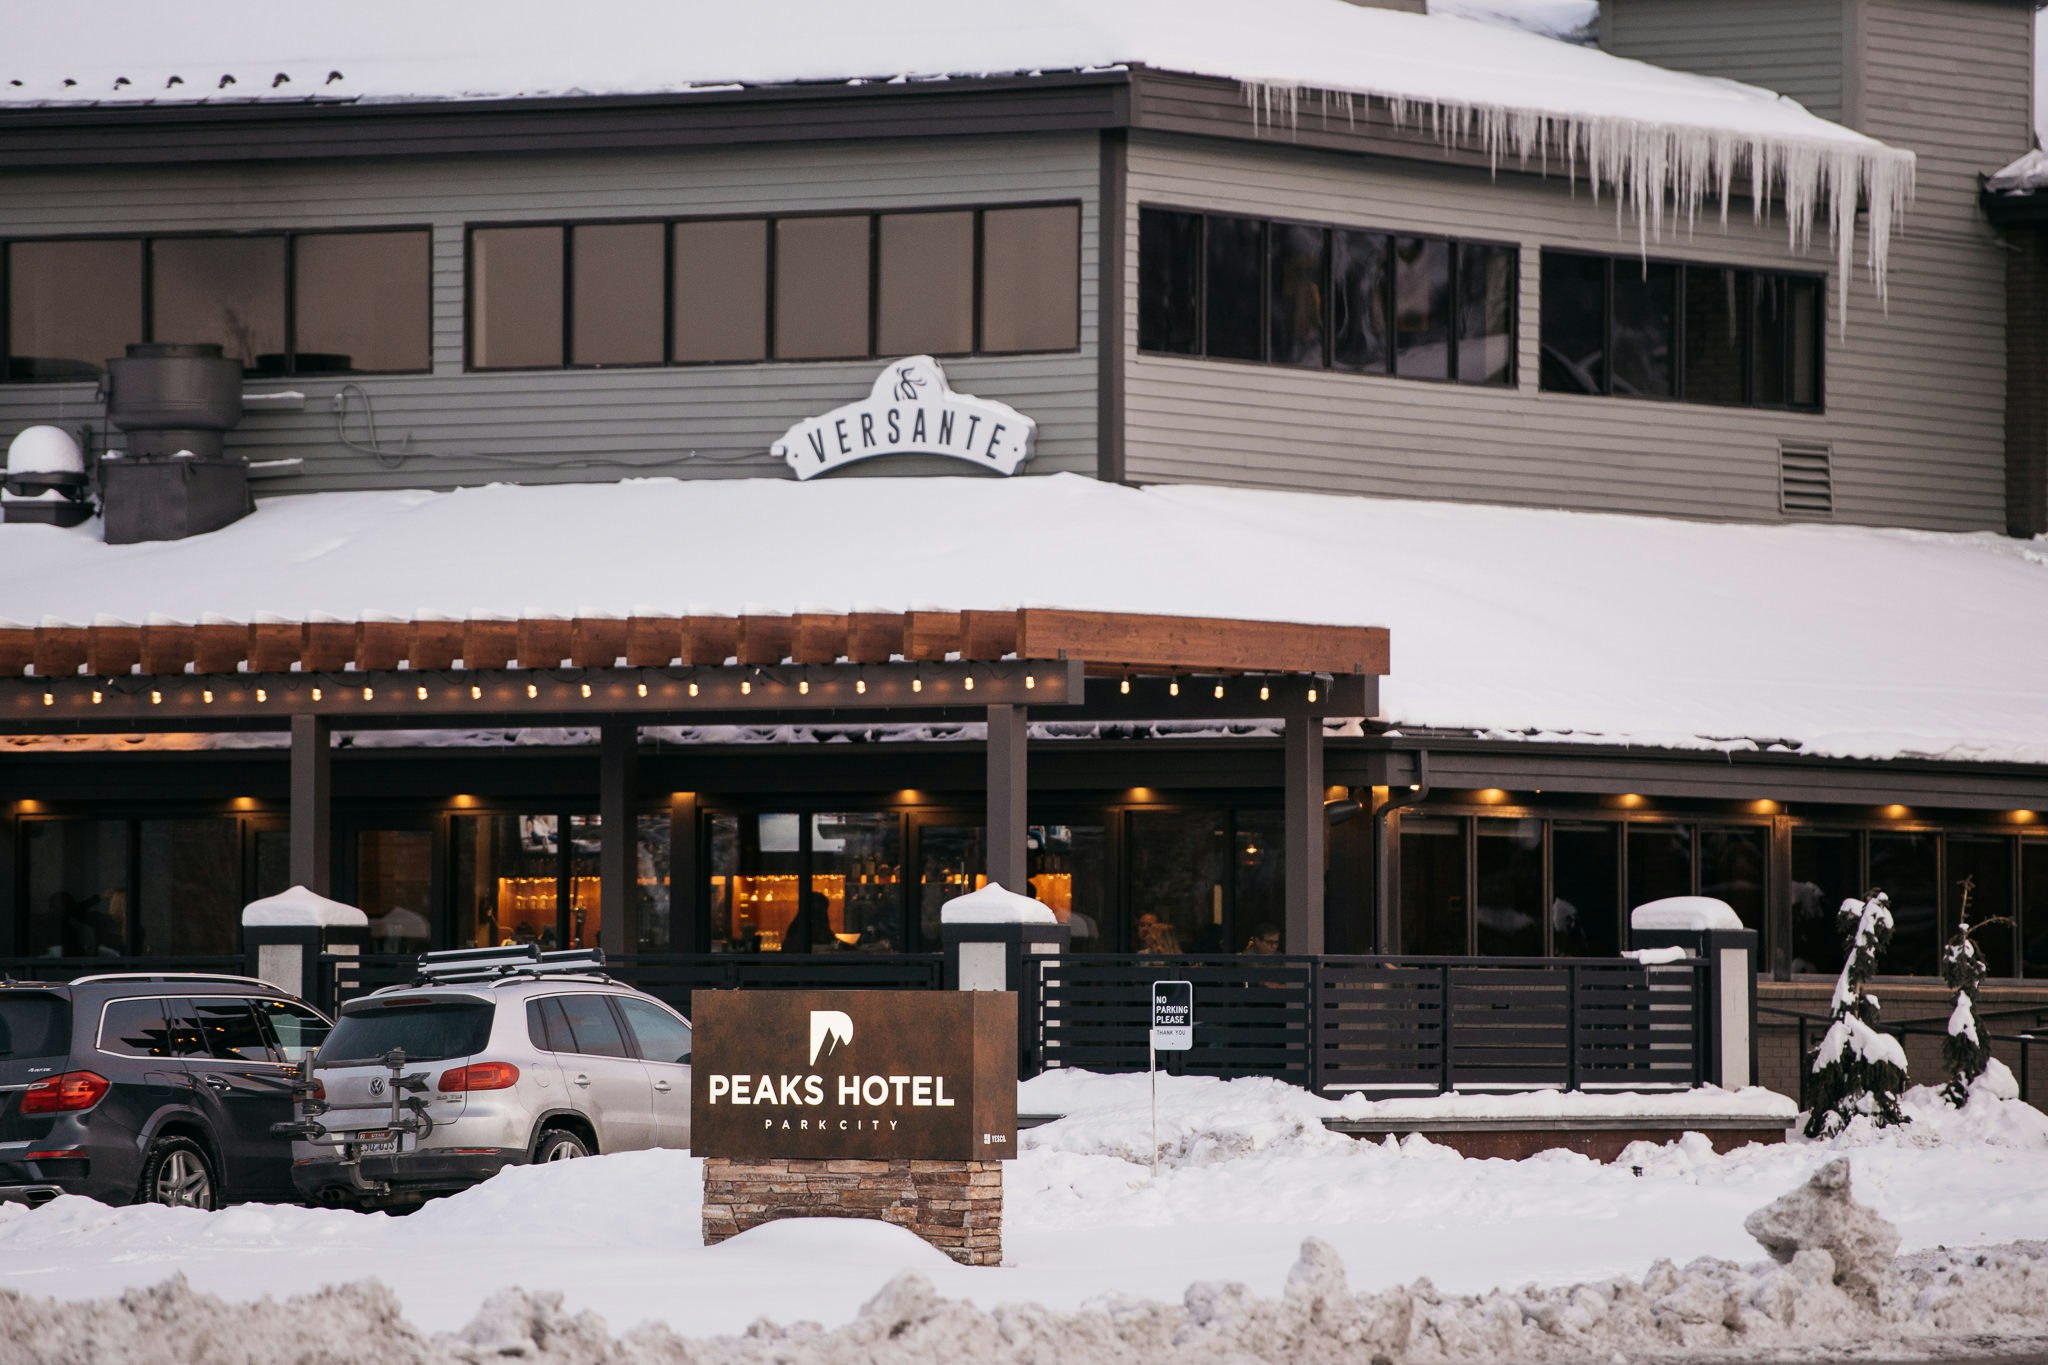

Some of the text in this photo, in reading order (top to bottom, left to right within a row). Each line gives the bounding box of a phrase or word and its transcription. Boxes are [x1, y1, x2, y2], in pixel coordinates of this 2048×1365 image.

[808, 408, 1006, 464] VERSANTE
[1156, 995, 1167, 1004] NO
[1156, 1006, 1188, 1014] PARKING
[1156, 1015, 1184, 1024] PLEASE
[709, 1075, 955, 1106] PEAKS HOTEL
